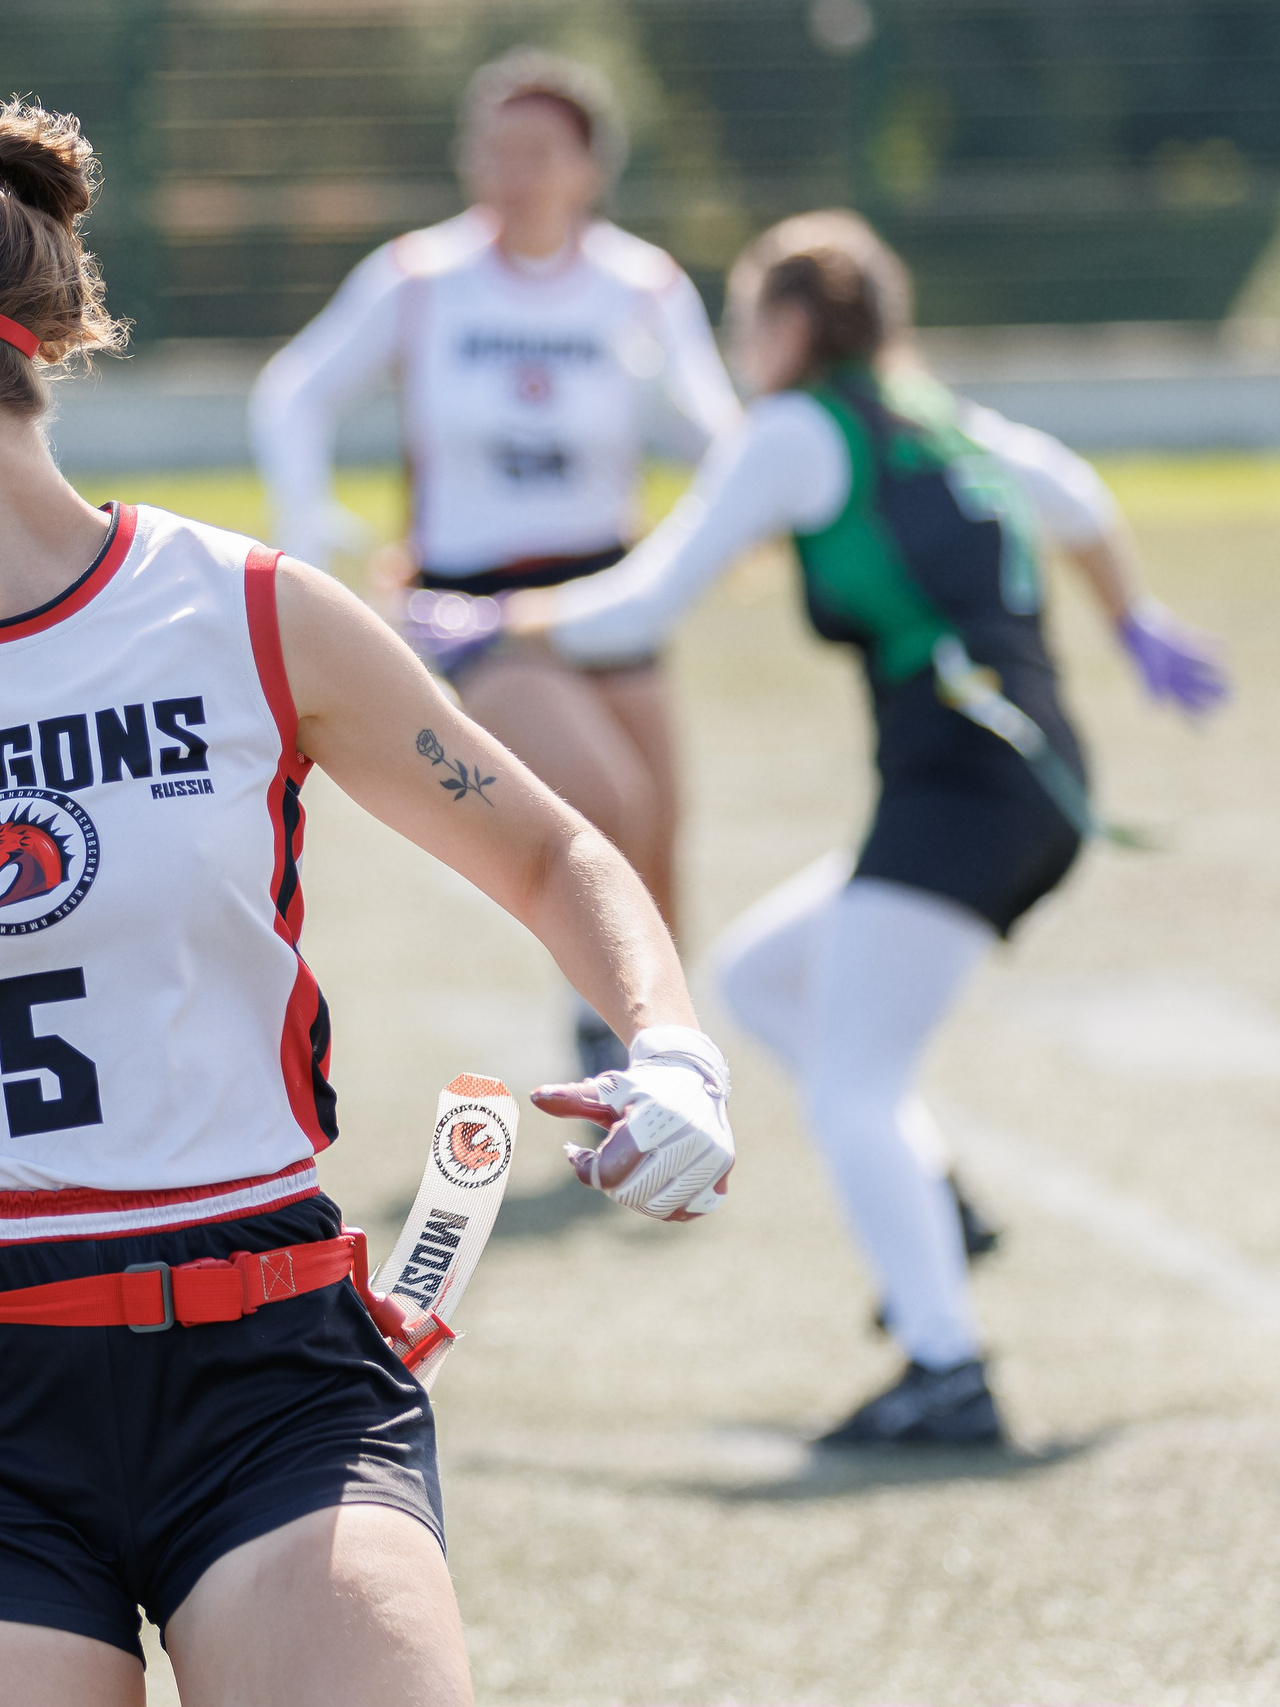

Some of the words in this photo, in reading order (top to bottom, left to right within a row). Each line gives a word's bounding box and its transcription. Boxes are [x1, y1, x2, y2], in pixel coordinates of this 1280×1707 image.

[150, 778, 214, 799] RUSSIA
[65, 801, 97, 883] МОСКОВСКИЙ
[55, 889, 84, 919] КЛУБ
